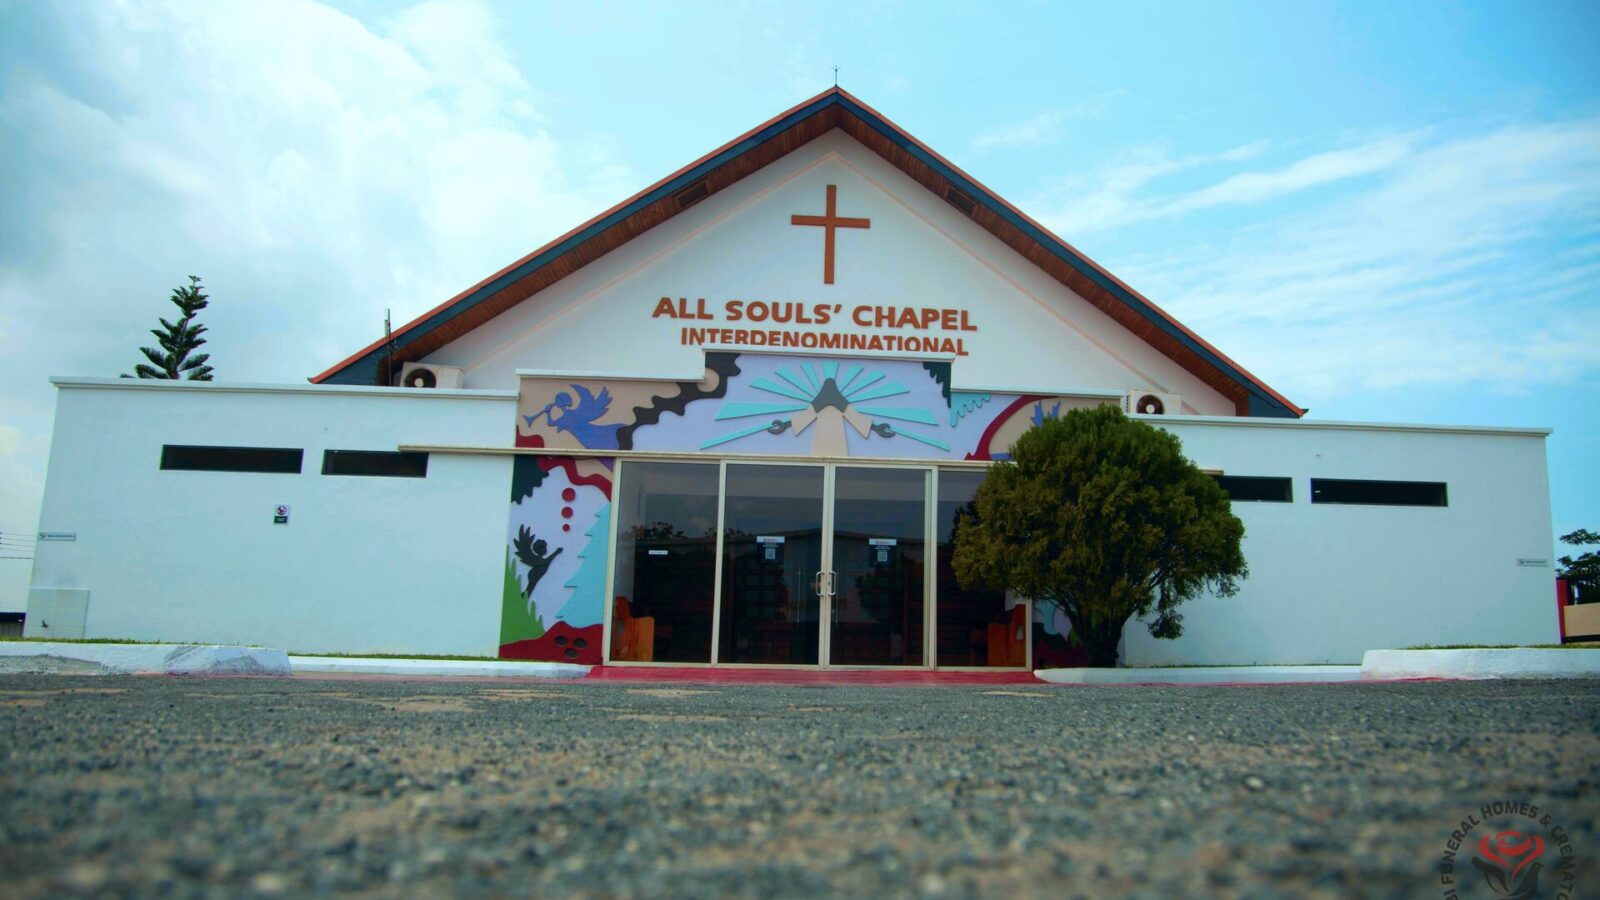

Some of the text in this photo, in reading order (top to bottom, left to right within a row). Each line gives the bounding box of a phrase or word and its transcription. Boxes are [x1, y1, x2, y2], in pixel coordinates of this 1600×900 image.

[652, 297, 714, 320] ALL
[852, 306, 977, 330] CHAPEL
[681, 327, 969, 355] INTERDENOMINATIONAL
